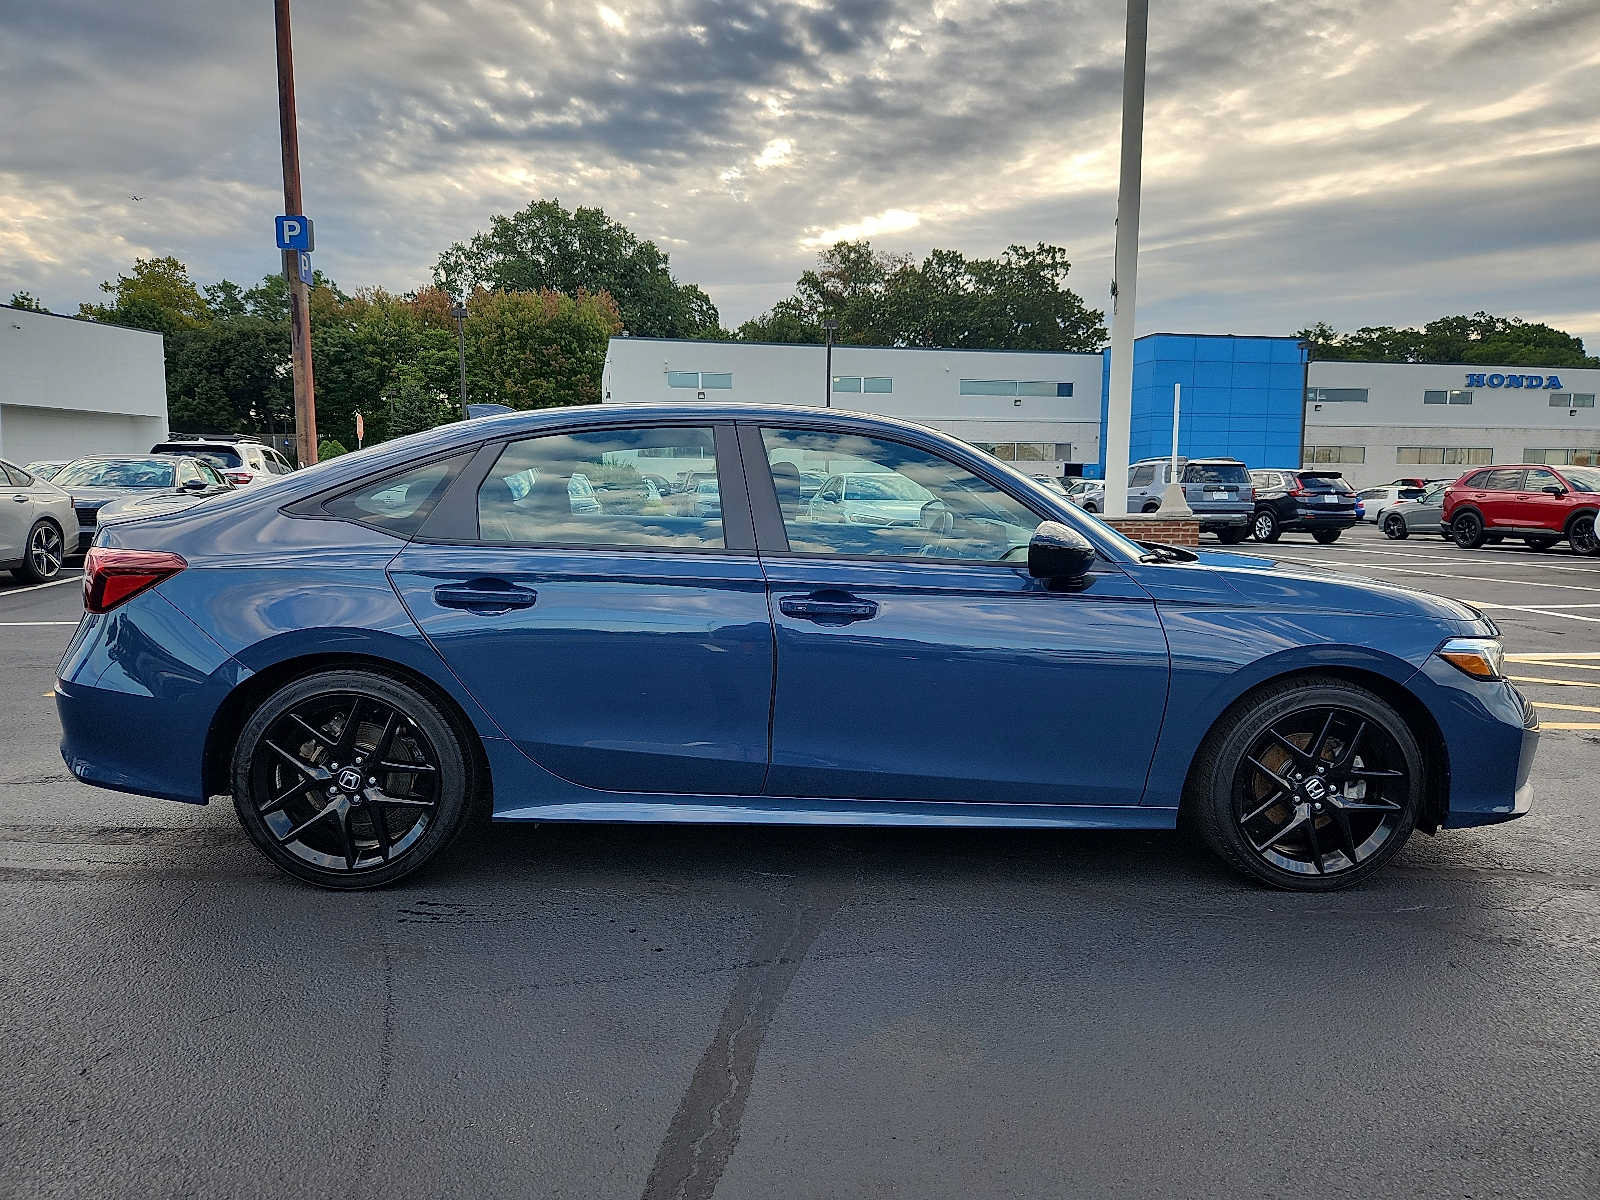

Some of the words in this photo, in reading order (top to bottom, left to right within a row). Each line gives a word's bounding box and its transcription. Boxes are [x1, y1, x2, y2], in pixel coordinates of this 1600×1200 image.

[283, 220, 301, 244] P
[301, 254, 309, 278] P
[1465, 373, 1563, 389] HONDA
